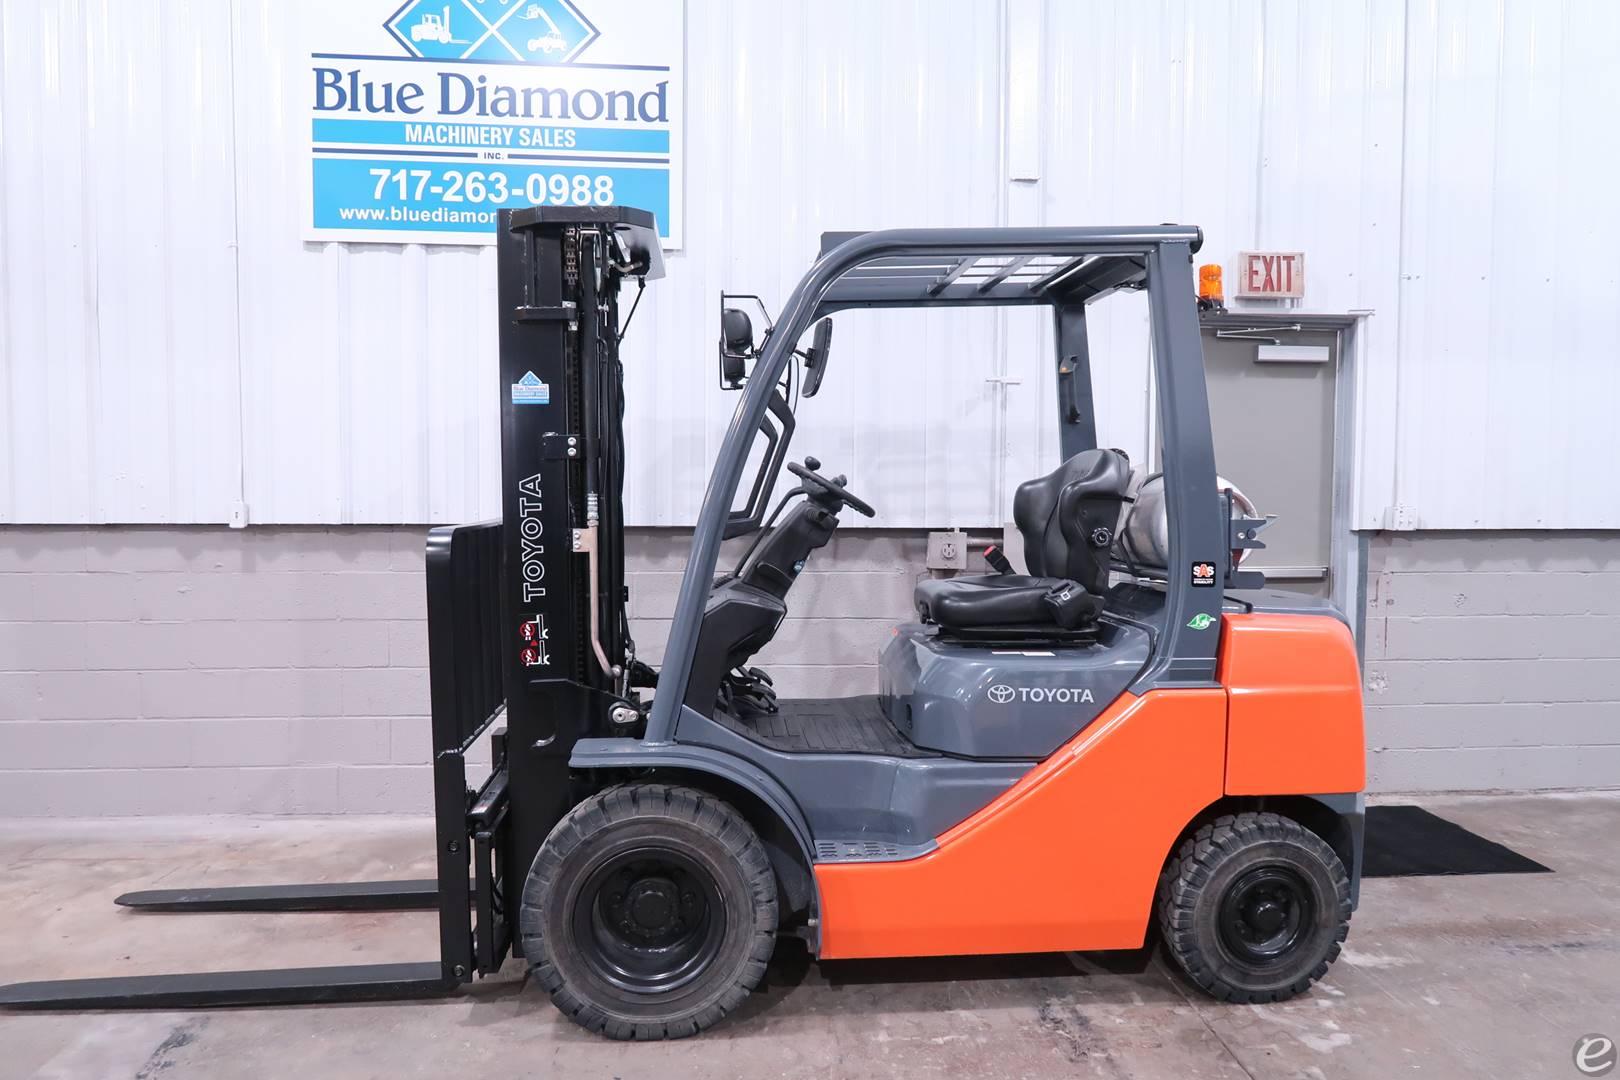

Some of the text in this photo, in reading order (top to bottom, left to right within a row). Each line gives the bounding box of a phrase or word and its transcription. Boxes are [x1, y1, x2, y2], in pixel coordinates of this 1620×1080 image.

[312, 67, 669, 123] Blue Diamond
[405, 123, 576, 148] MACHINERY SALES
[483, 151, 505, 160] INC.
[369, 168, 615, 206] 717-263-0988
[1248, 255, 1296, 292] EXIT
[519, 473, 546, 602] TOYOTA
[1193, 564, 1215, 578] SAS
[1018, 688, 1095, 703] TOYOTA
